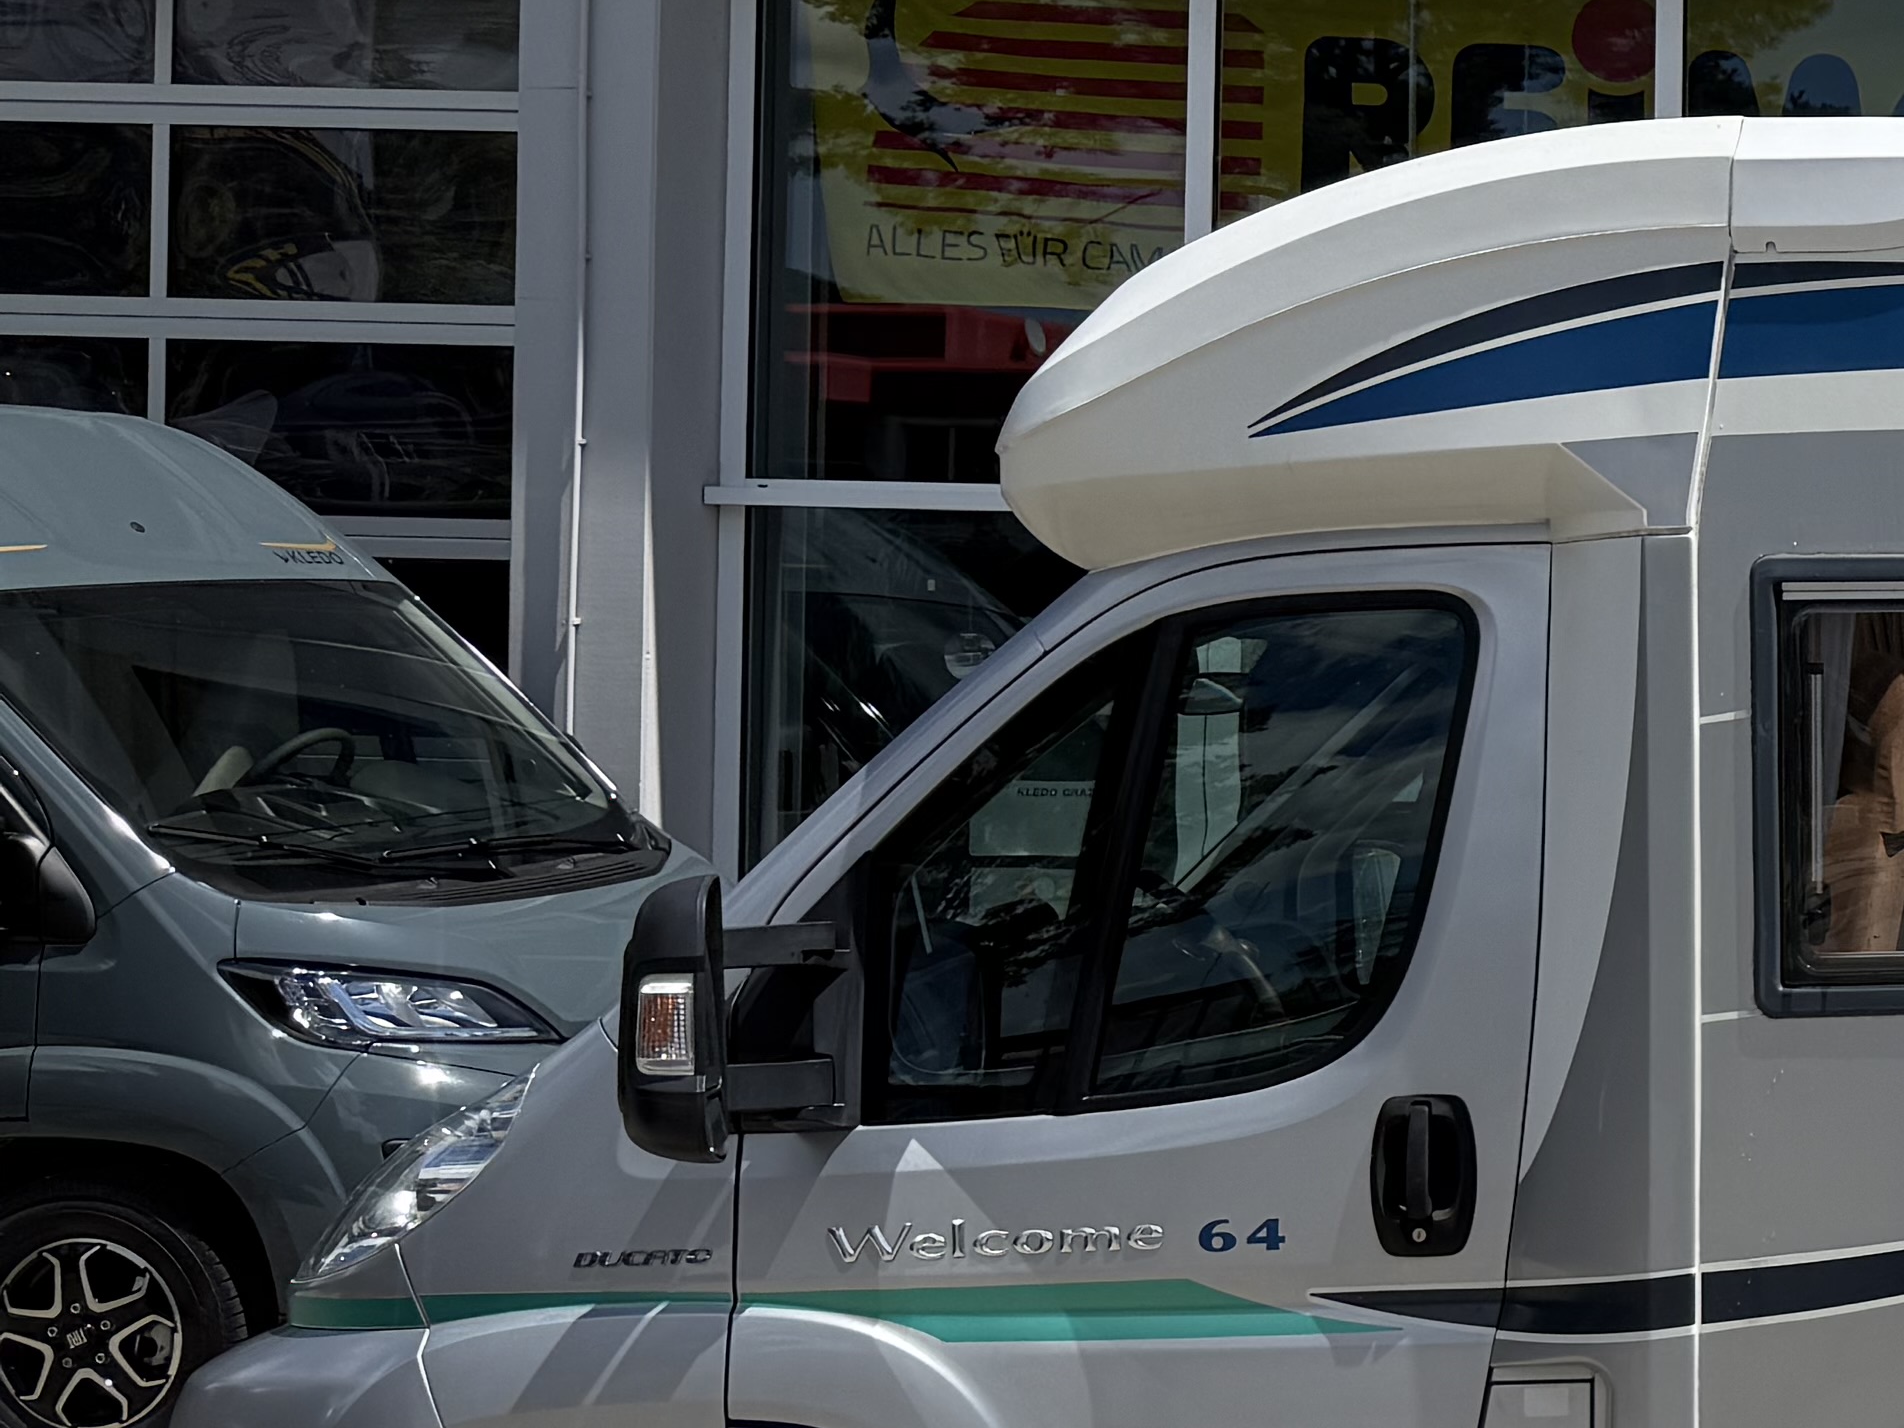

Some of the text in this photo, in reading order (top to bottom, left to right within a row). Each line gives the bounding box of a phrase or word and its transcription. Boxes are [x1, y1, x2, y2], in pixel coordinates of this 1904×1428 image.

[866, 224, 988, 262] ALLES
[995, 230, 1069, 268] FÜR
[286, 550, 345, 565] KLEDO
[827, 1217, 1287, 1264] Welcome 64
[573, 1248, 714, 1269] DUCATO
